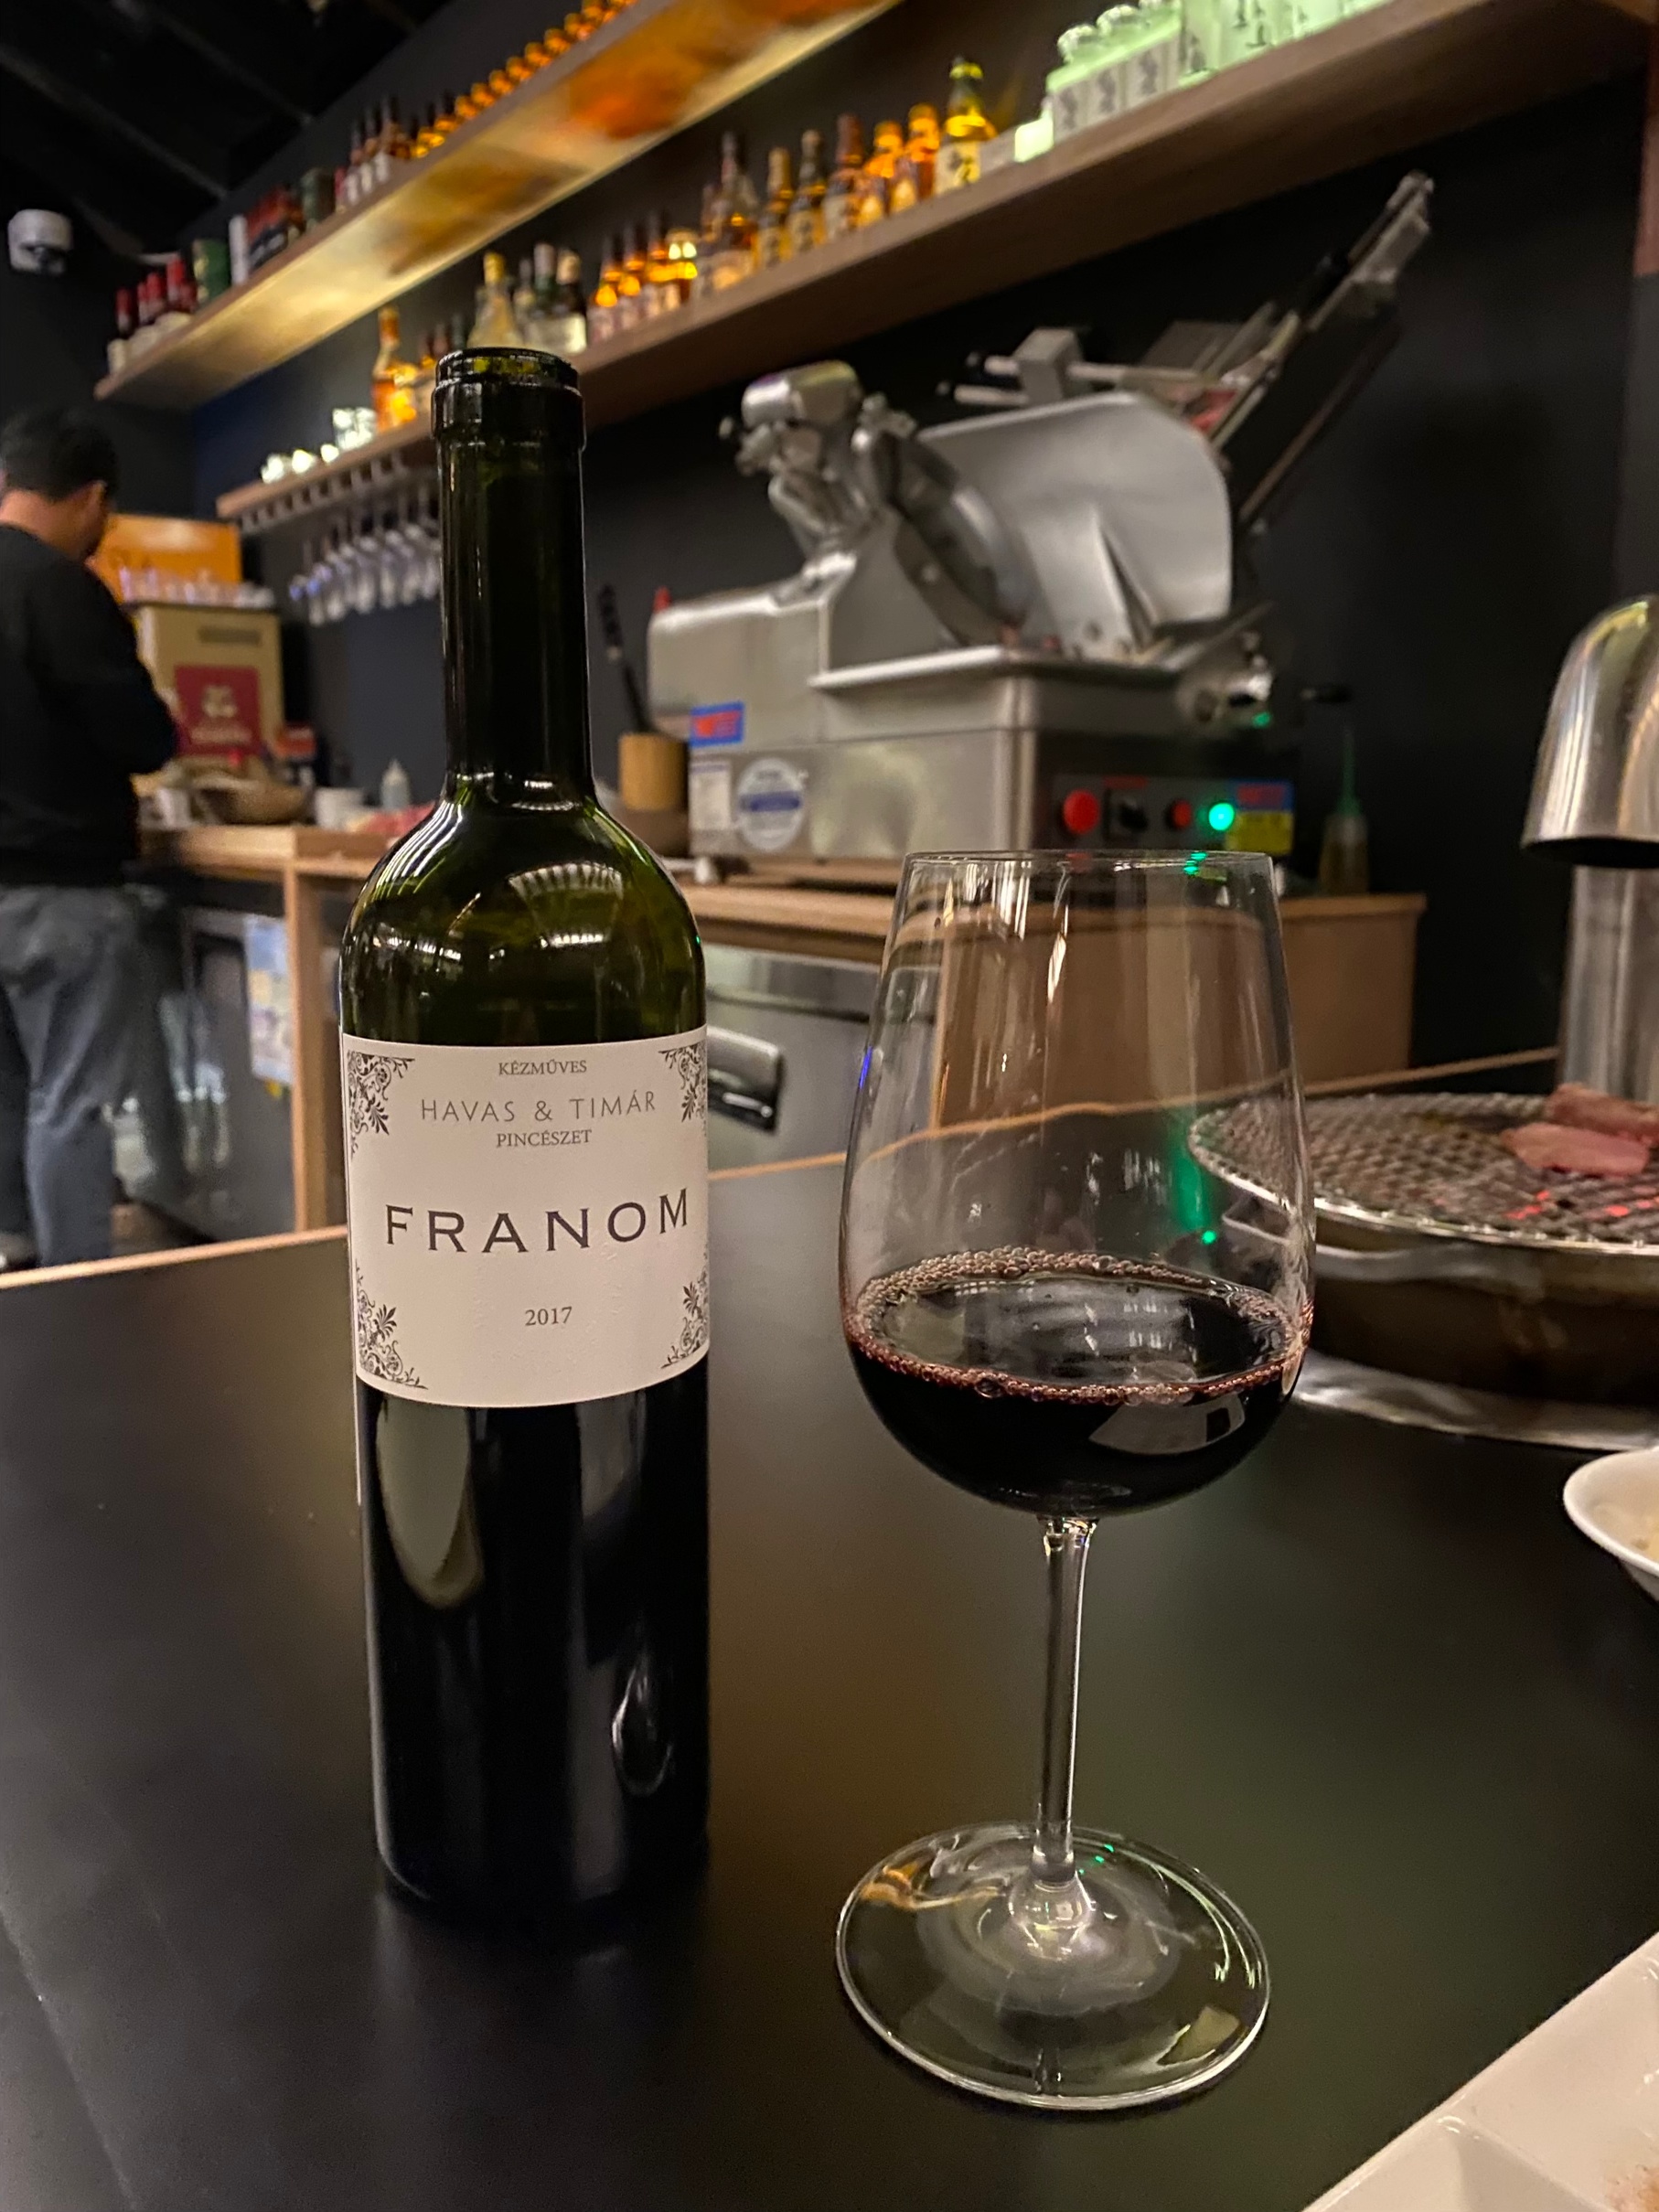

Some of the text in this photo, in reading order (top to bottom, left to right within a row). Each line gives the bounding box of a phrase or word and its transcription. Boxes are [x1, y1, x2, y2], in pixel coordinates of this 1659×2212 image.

[498, 1059, 587, 1075] KÉZMŰVES
[421, 1090, 656, 1123] HAVAS & TIMÁR
[496, 1129, 592, 1148] PINCÉSZET
[385, 1187, 688, 1253] FRANOM
[524, 1306, 573, 1327] 2017
